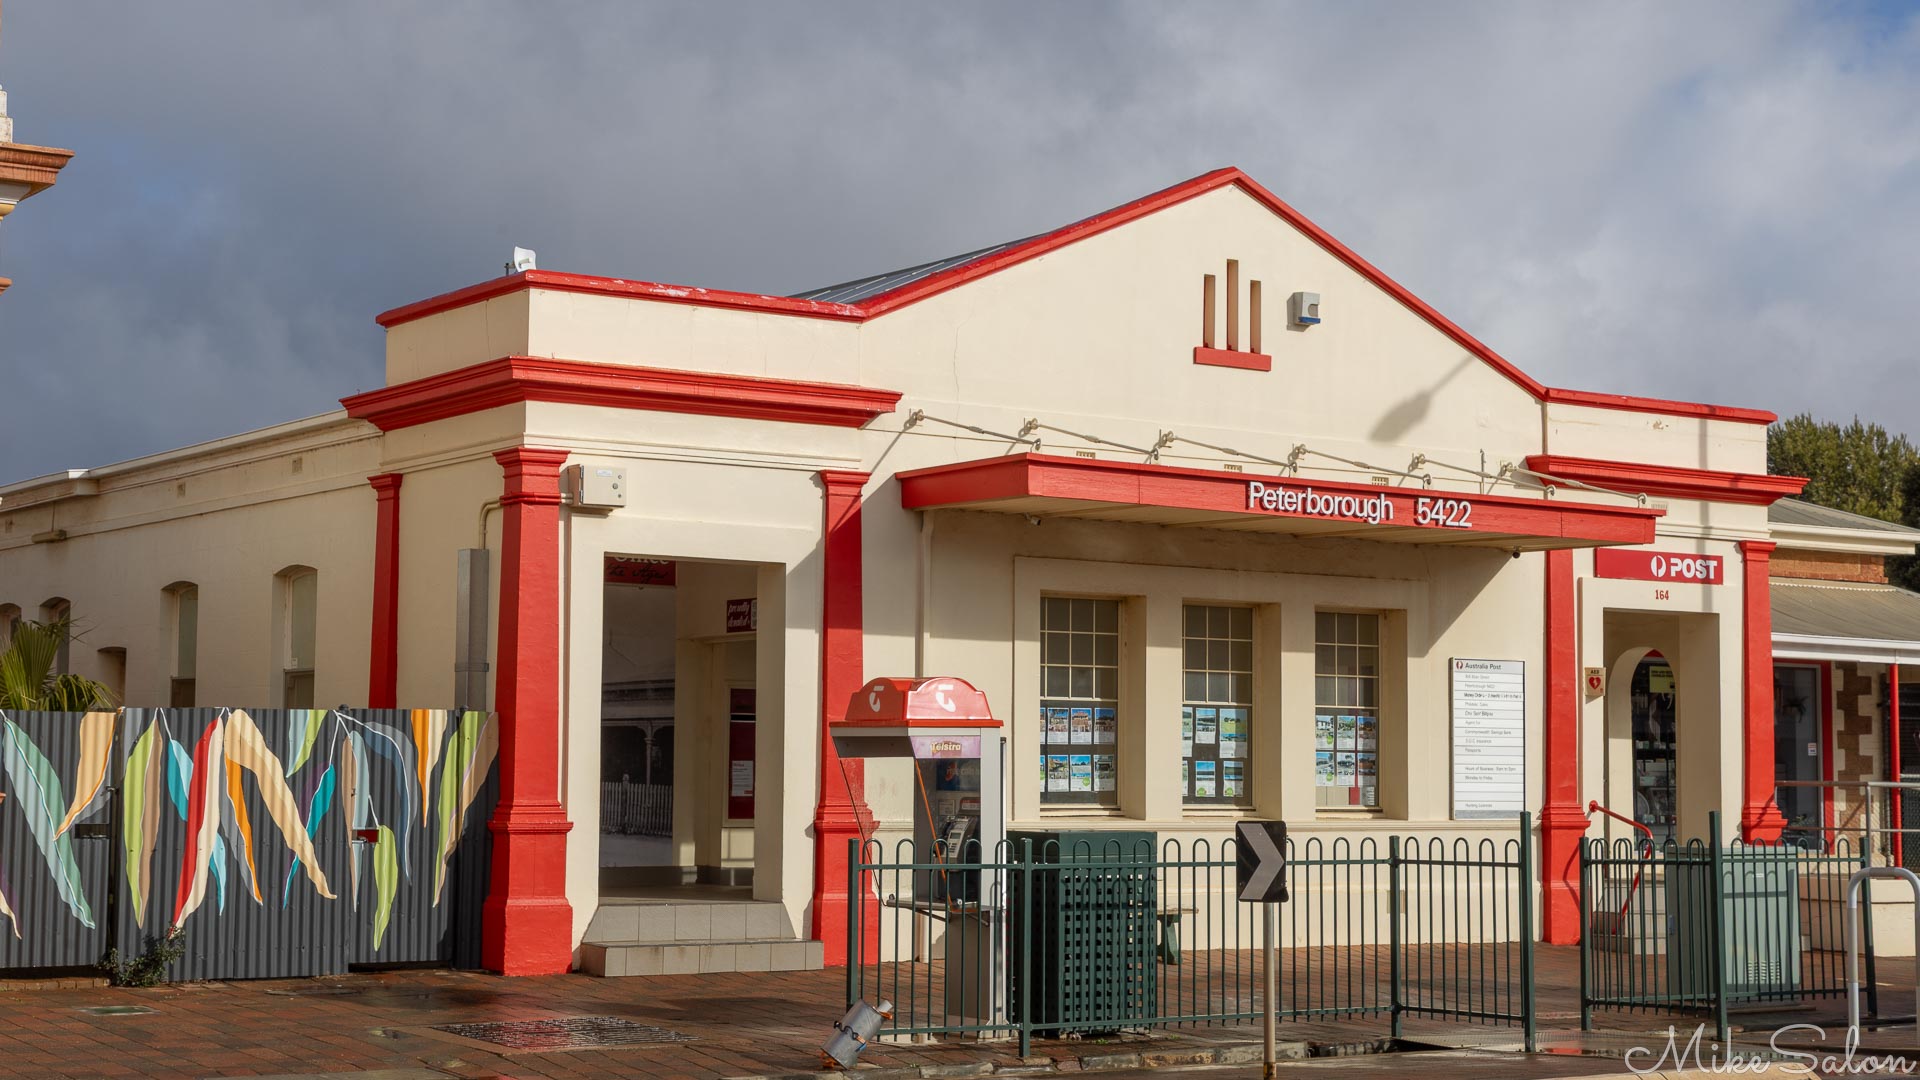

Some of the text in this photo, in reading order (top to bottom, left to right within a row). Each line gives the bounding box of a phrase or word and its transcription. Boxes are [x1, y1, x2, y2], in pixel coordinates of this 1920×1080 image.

[1249, 481, 1473, 528] Peterborough 5422
[1670, 557, 1718, 580] POST
[1655, 589, 1669, 600] 164
[1465, 662, 1502, 671] Australia Post
[929, 742, 961, 752] Telstra
